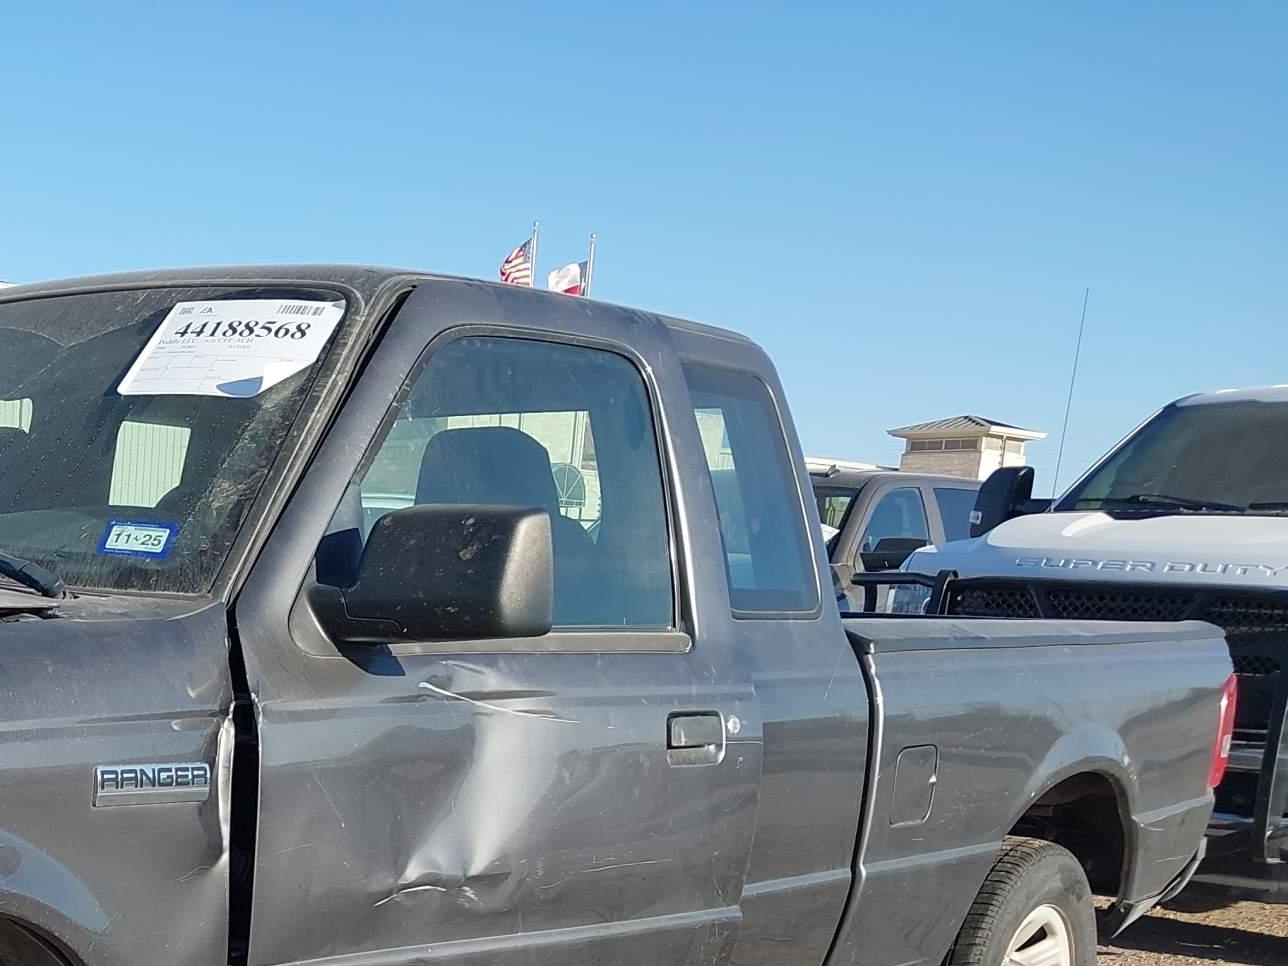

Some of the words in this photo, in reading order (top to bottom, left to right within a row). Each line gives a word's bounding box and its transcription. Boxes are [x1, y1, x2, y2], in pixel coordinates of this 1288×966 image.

[175, 320, 311, 340] 44188568
[1015, 557, 1157, 572] SUPER
[1163, 561, 1288, 576] DUTY
[100, 766, 208, 790] RANGER
